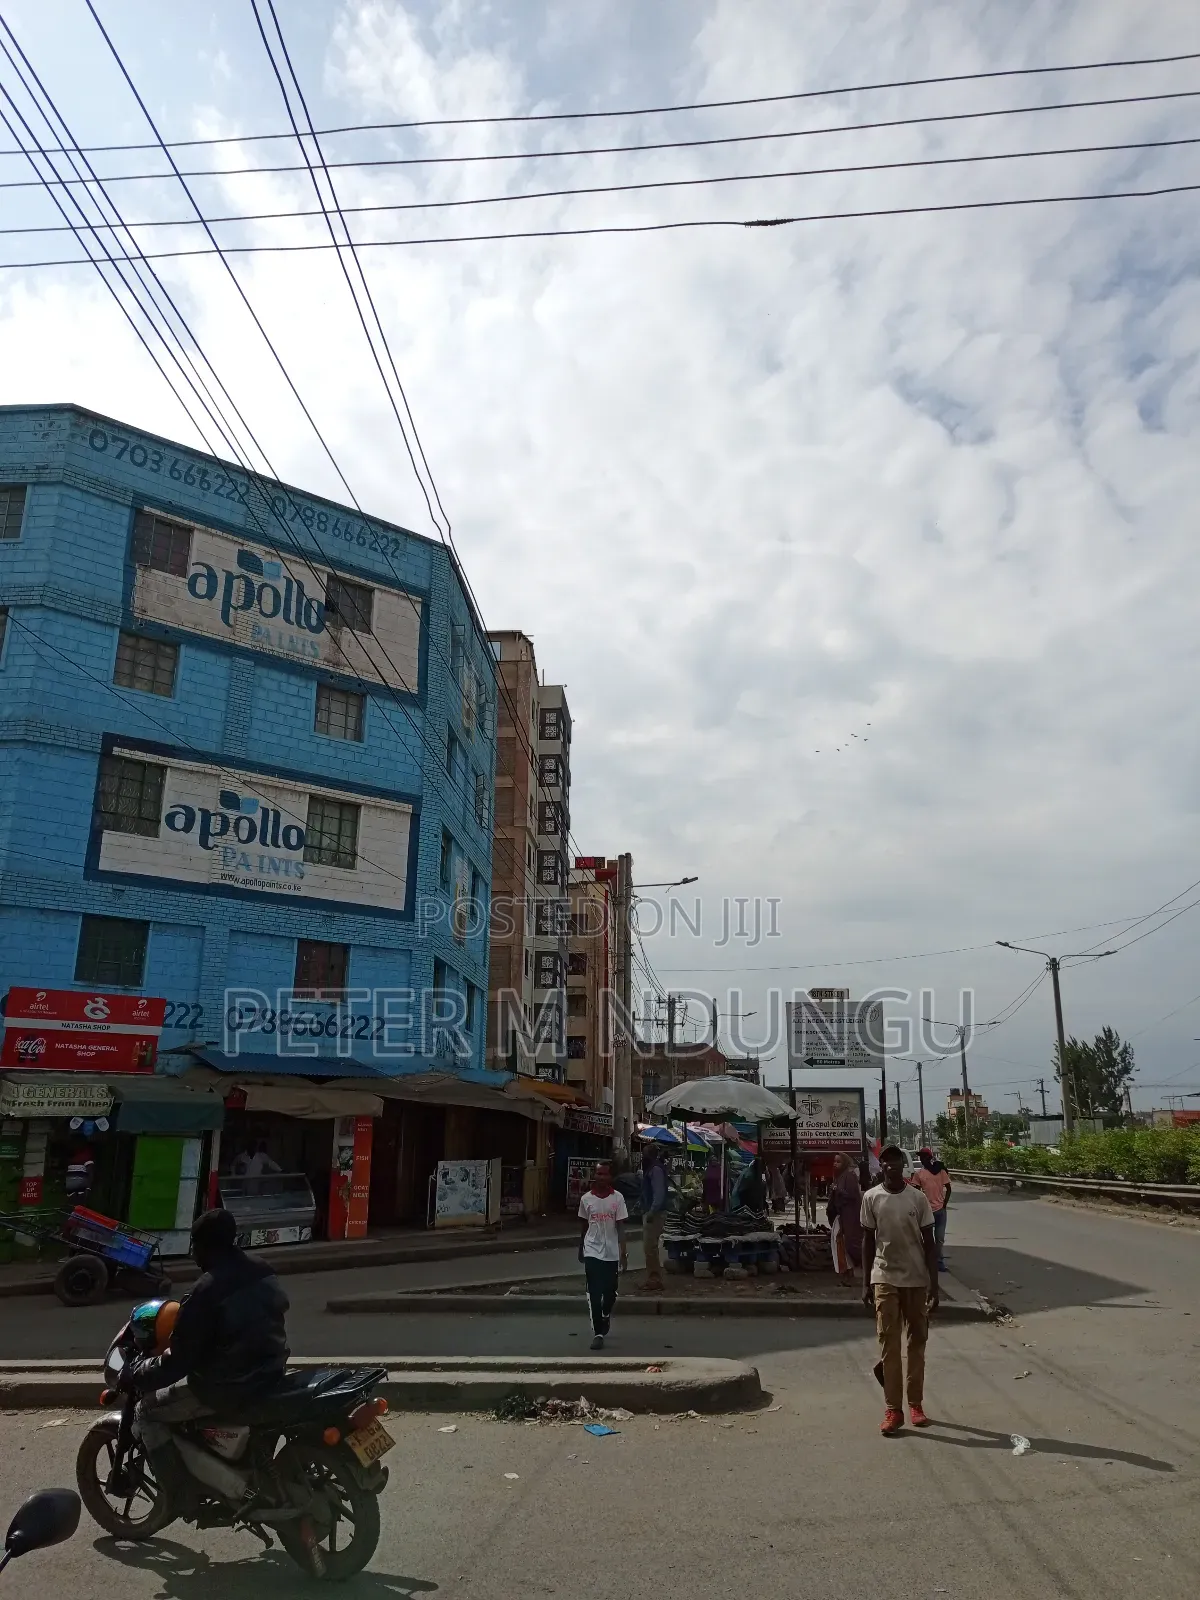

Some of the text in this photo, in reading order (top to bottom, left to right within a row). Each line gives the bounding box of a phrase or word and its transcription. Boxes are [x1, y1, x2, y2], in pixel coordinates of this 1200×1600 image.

[187, 561, 328, 635] apollo
[164, 803, 306, 852] apollo
[221, 845, 306, 880] PAINTS
[29, 1002, 50, 1011] airtel
[131, 1010, 150, 1018] airtel
[61, 1022, 92, 1030] NATASHA
[55, 1042, 119, 1052] NATASHA GENERAL
[22, 1086, 94, 1099] GENERAL
[11, 1099, 44, 1108] Fresh
[47, 1099, 76, 1108] From
[831, 1120, 859, 1129] Church
